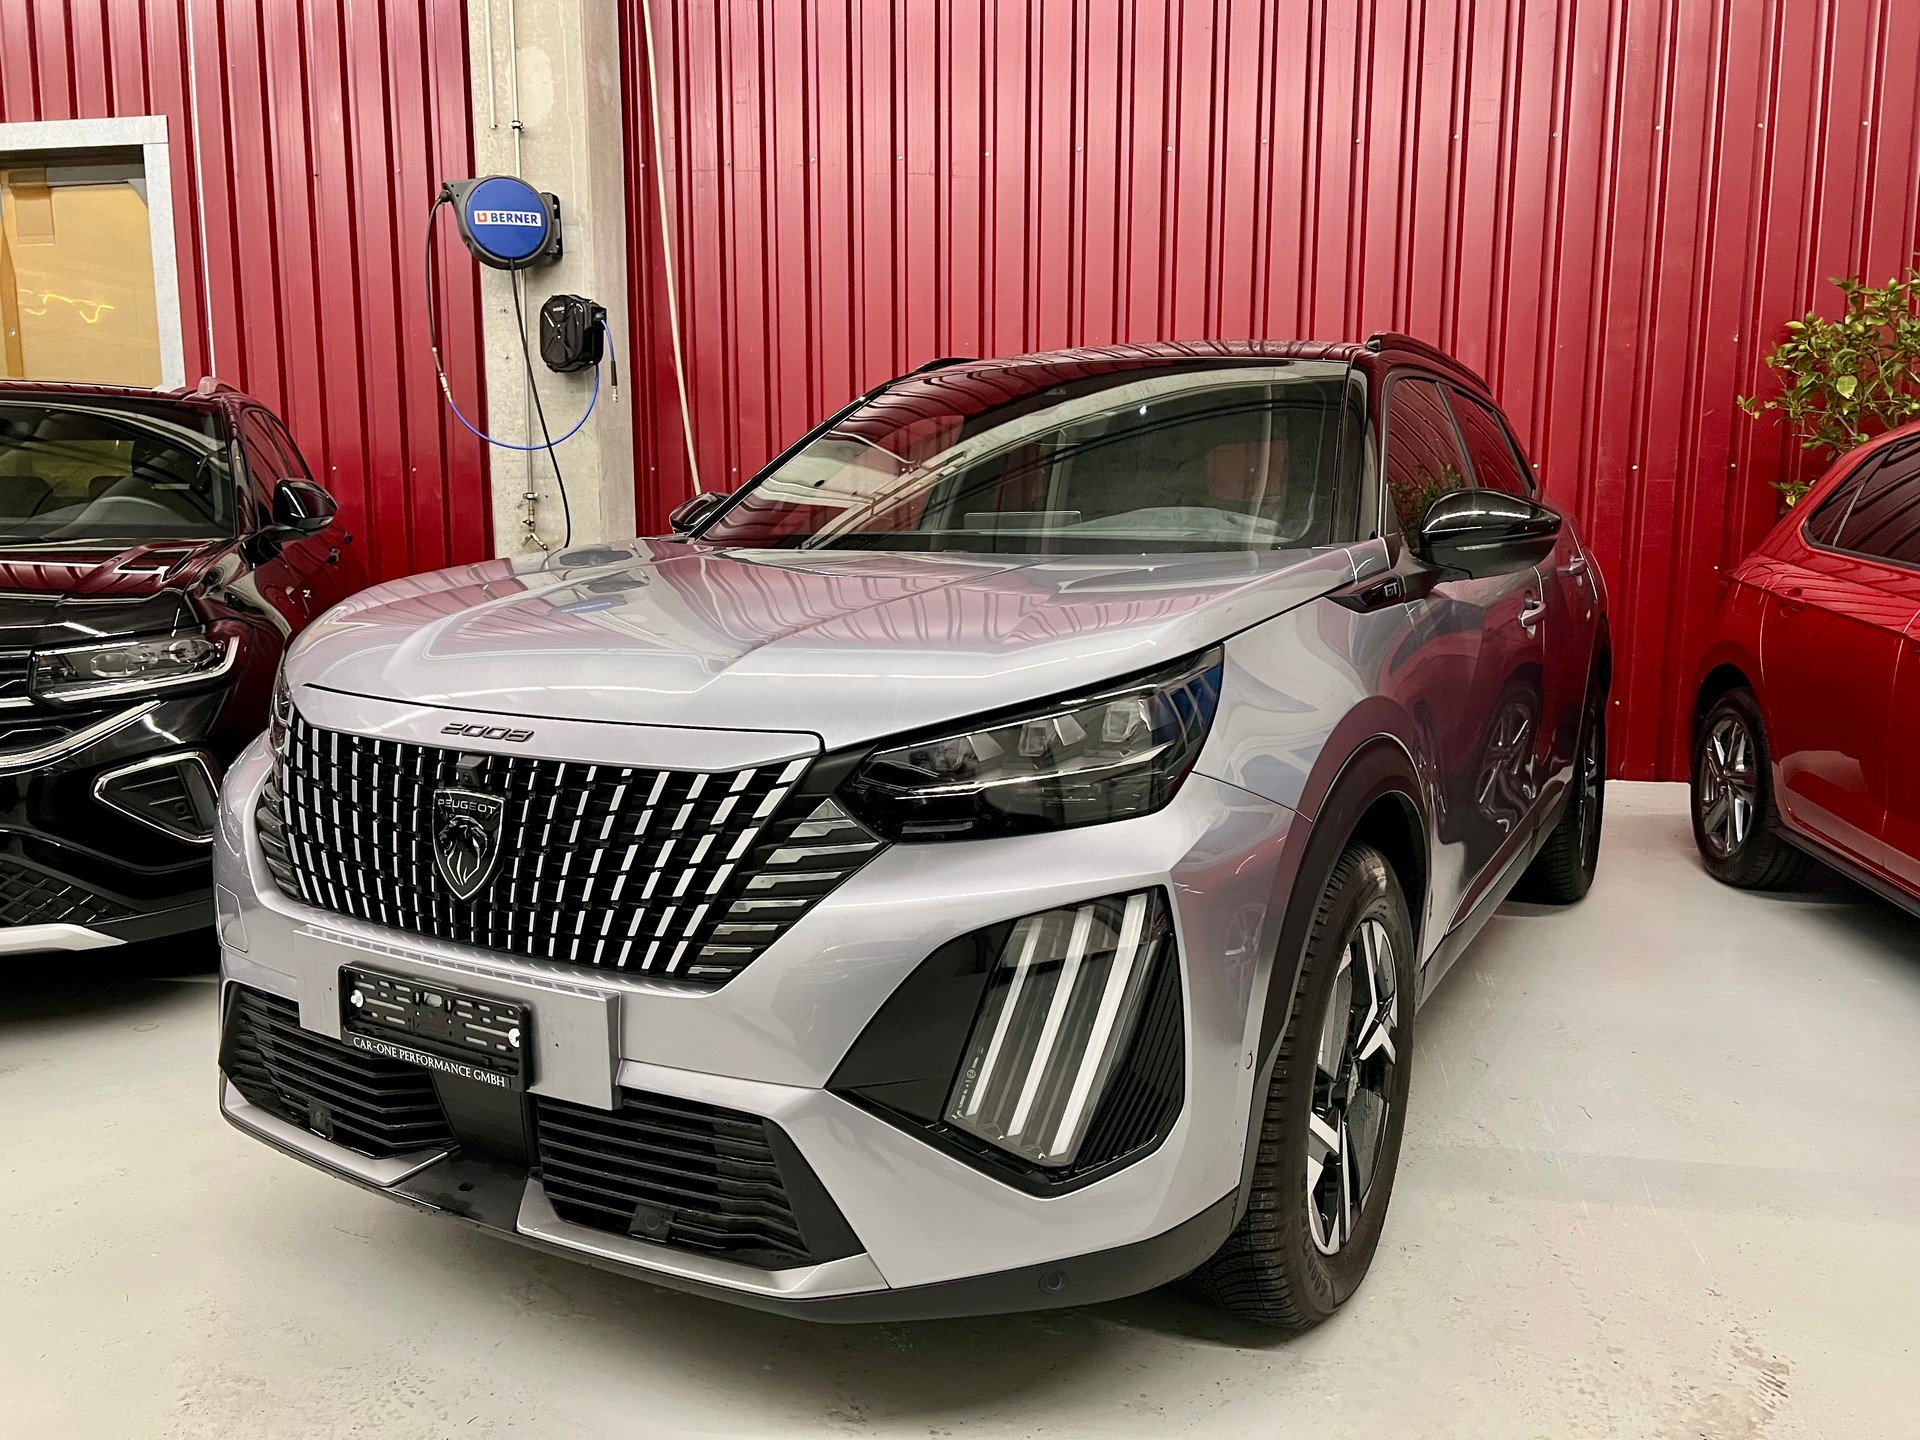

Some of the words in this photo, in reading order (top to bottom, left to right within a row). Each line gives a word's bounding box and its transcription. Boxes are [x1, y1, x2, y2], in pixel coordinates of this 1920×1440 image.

[490, 212, 539, 225] BERNER
[1383, 582, 1398, 597] GT
[440, 722, 535, 743] 2008
[437, 798, 497, 815] PEUGEOT
[353, 1036, 398, 1058] CAR-ONE
[399, 1049, 471, 1078] PERFORMANCE
[473, 1068, 505, 1087] GMBH
